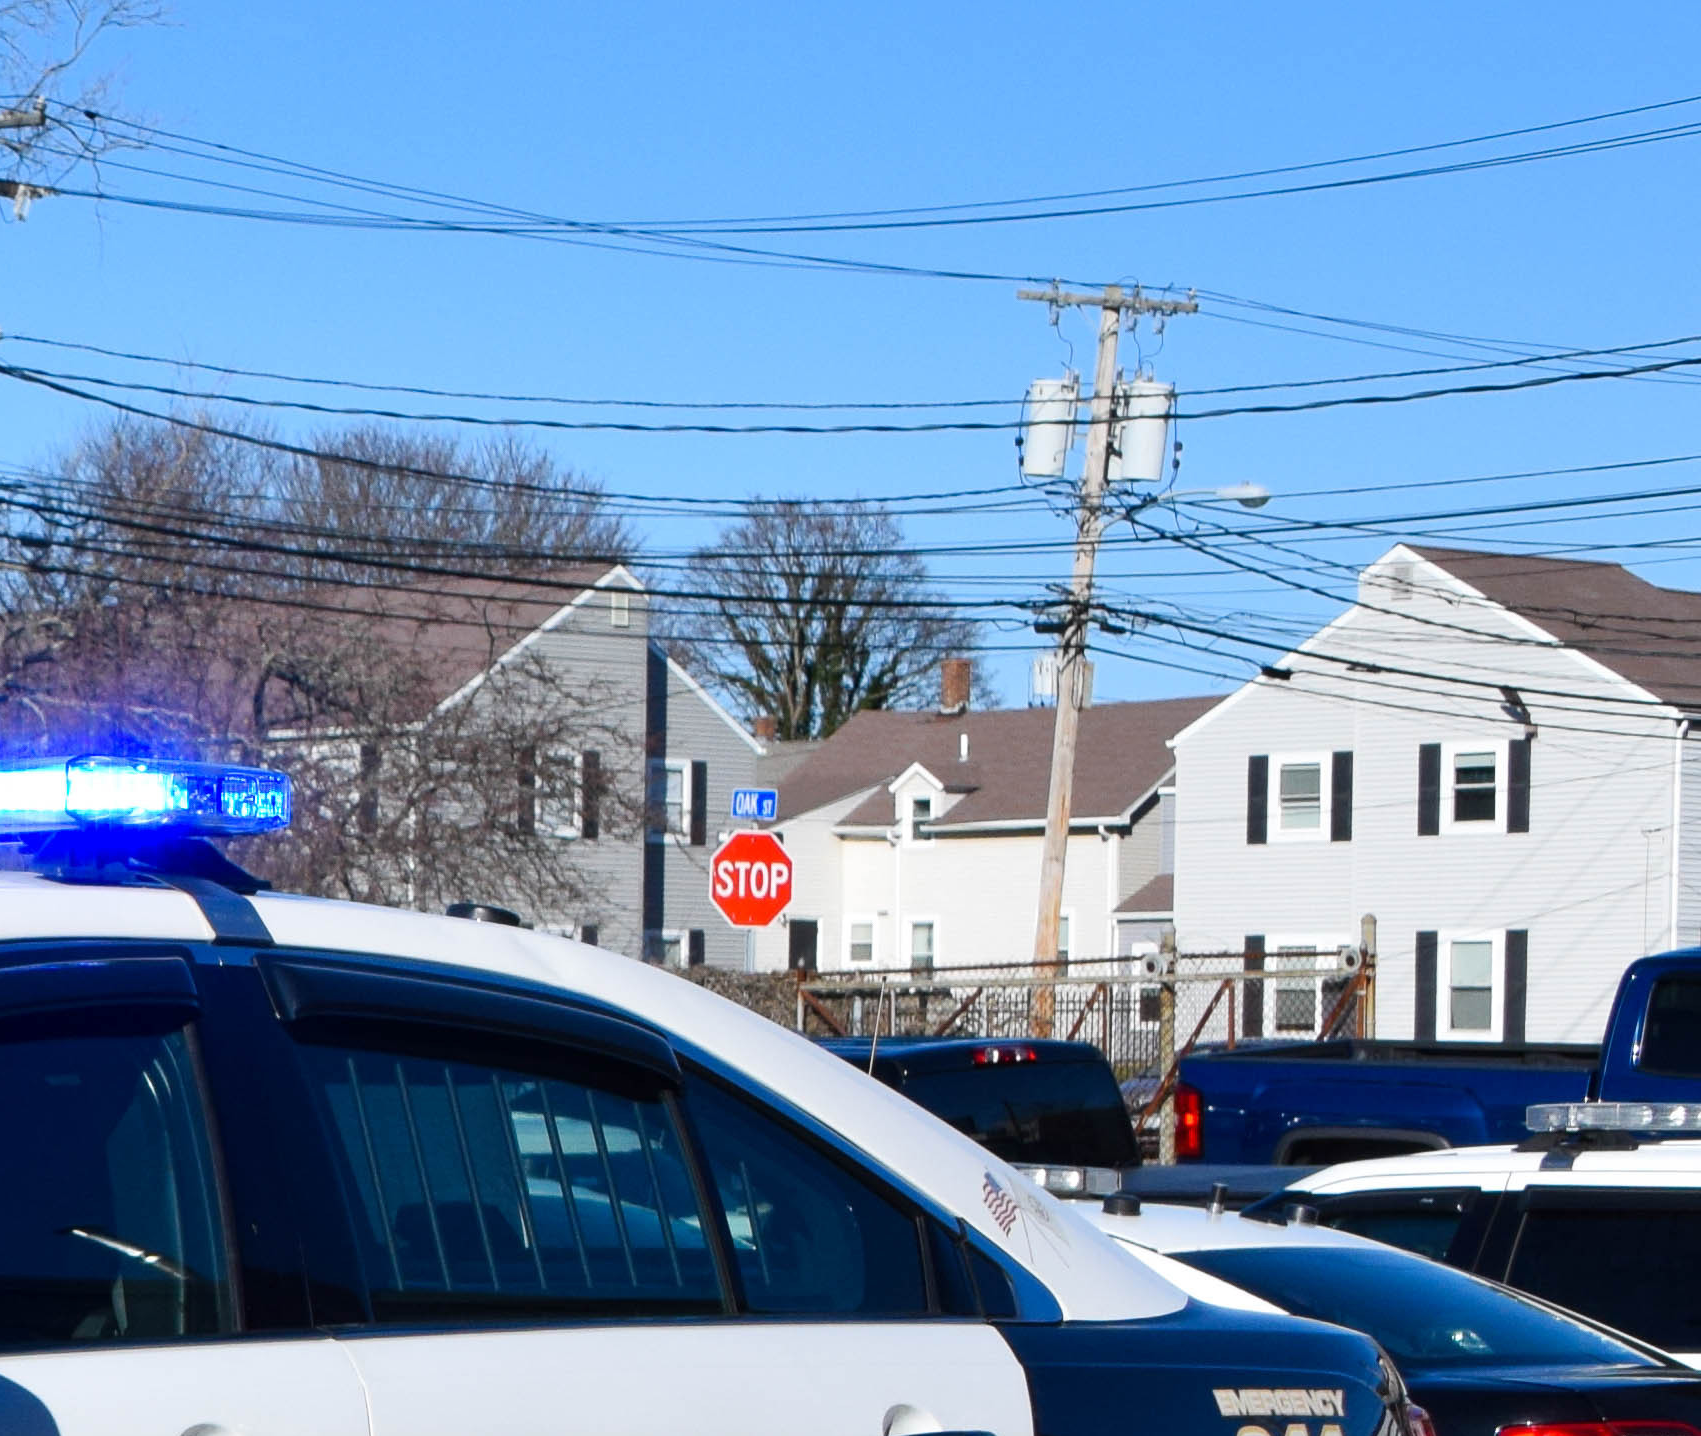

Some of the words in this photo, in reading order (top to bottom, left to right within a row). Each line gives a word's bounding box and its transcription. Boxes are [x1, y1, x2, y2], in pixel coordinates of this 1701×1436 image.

[735, 793, 757, 816] OAK
[715, 860, 789, 899] STOP
[1212, 1389, 1345, 1417] EMERGENCY
